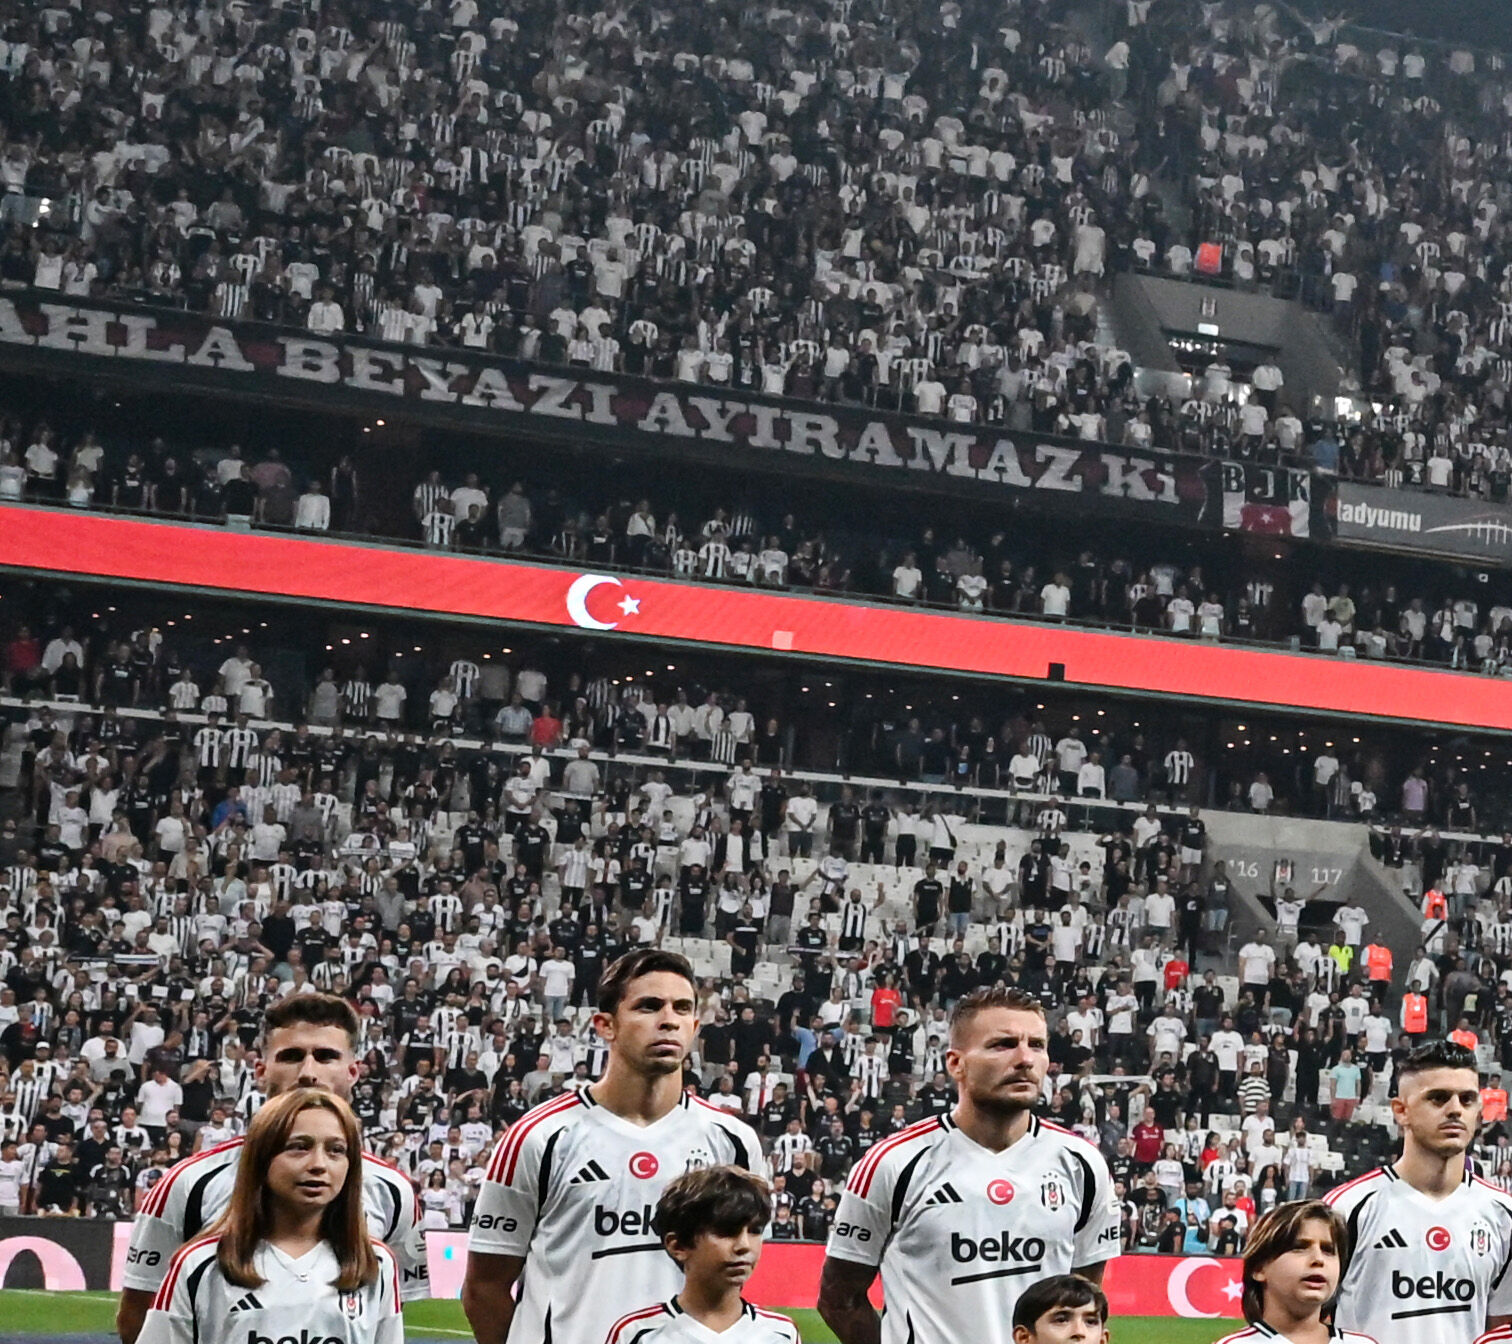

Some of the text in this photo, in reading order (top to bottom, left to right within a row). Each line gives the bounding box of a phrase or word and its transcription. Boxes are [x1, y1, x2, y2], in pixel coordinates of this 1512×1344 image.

[276, 336, 618, 425] BEYAZI
[638, 392, 1083, 492] AYIRAMAZ
[1222, 461, 1310, 502] BJK
[1338, 499, 1422, 532] tadyumu
[595, 1204, 661, 1238] bek
[951, 1231, 1047, 1264] beko
[1391, 1270, 1477, 1301] beko
